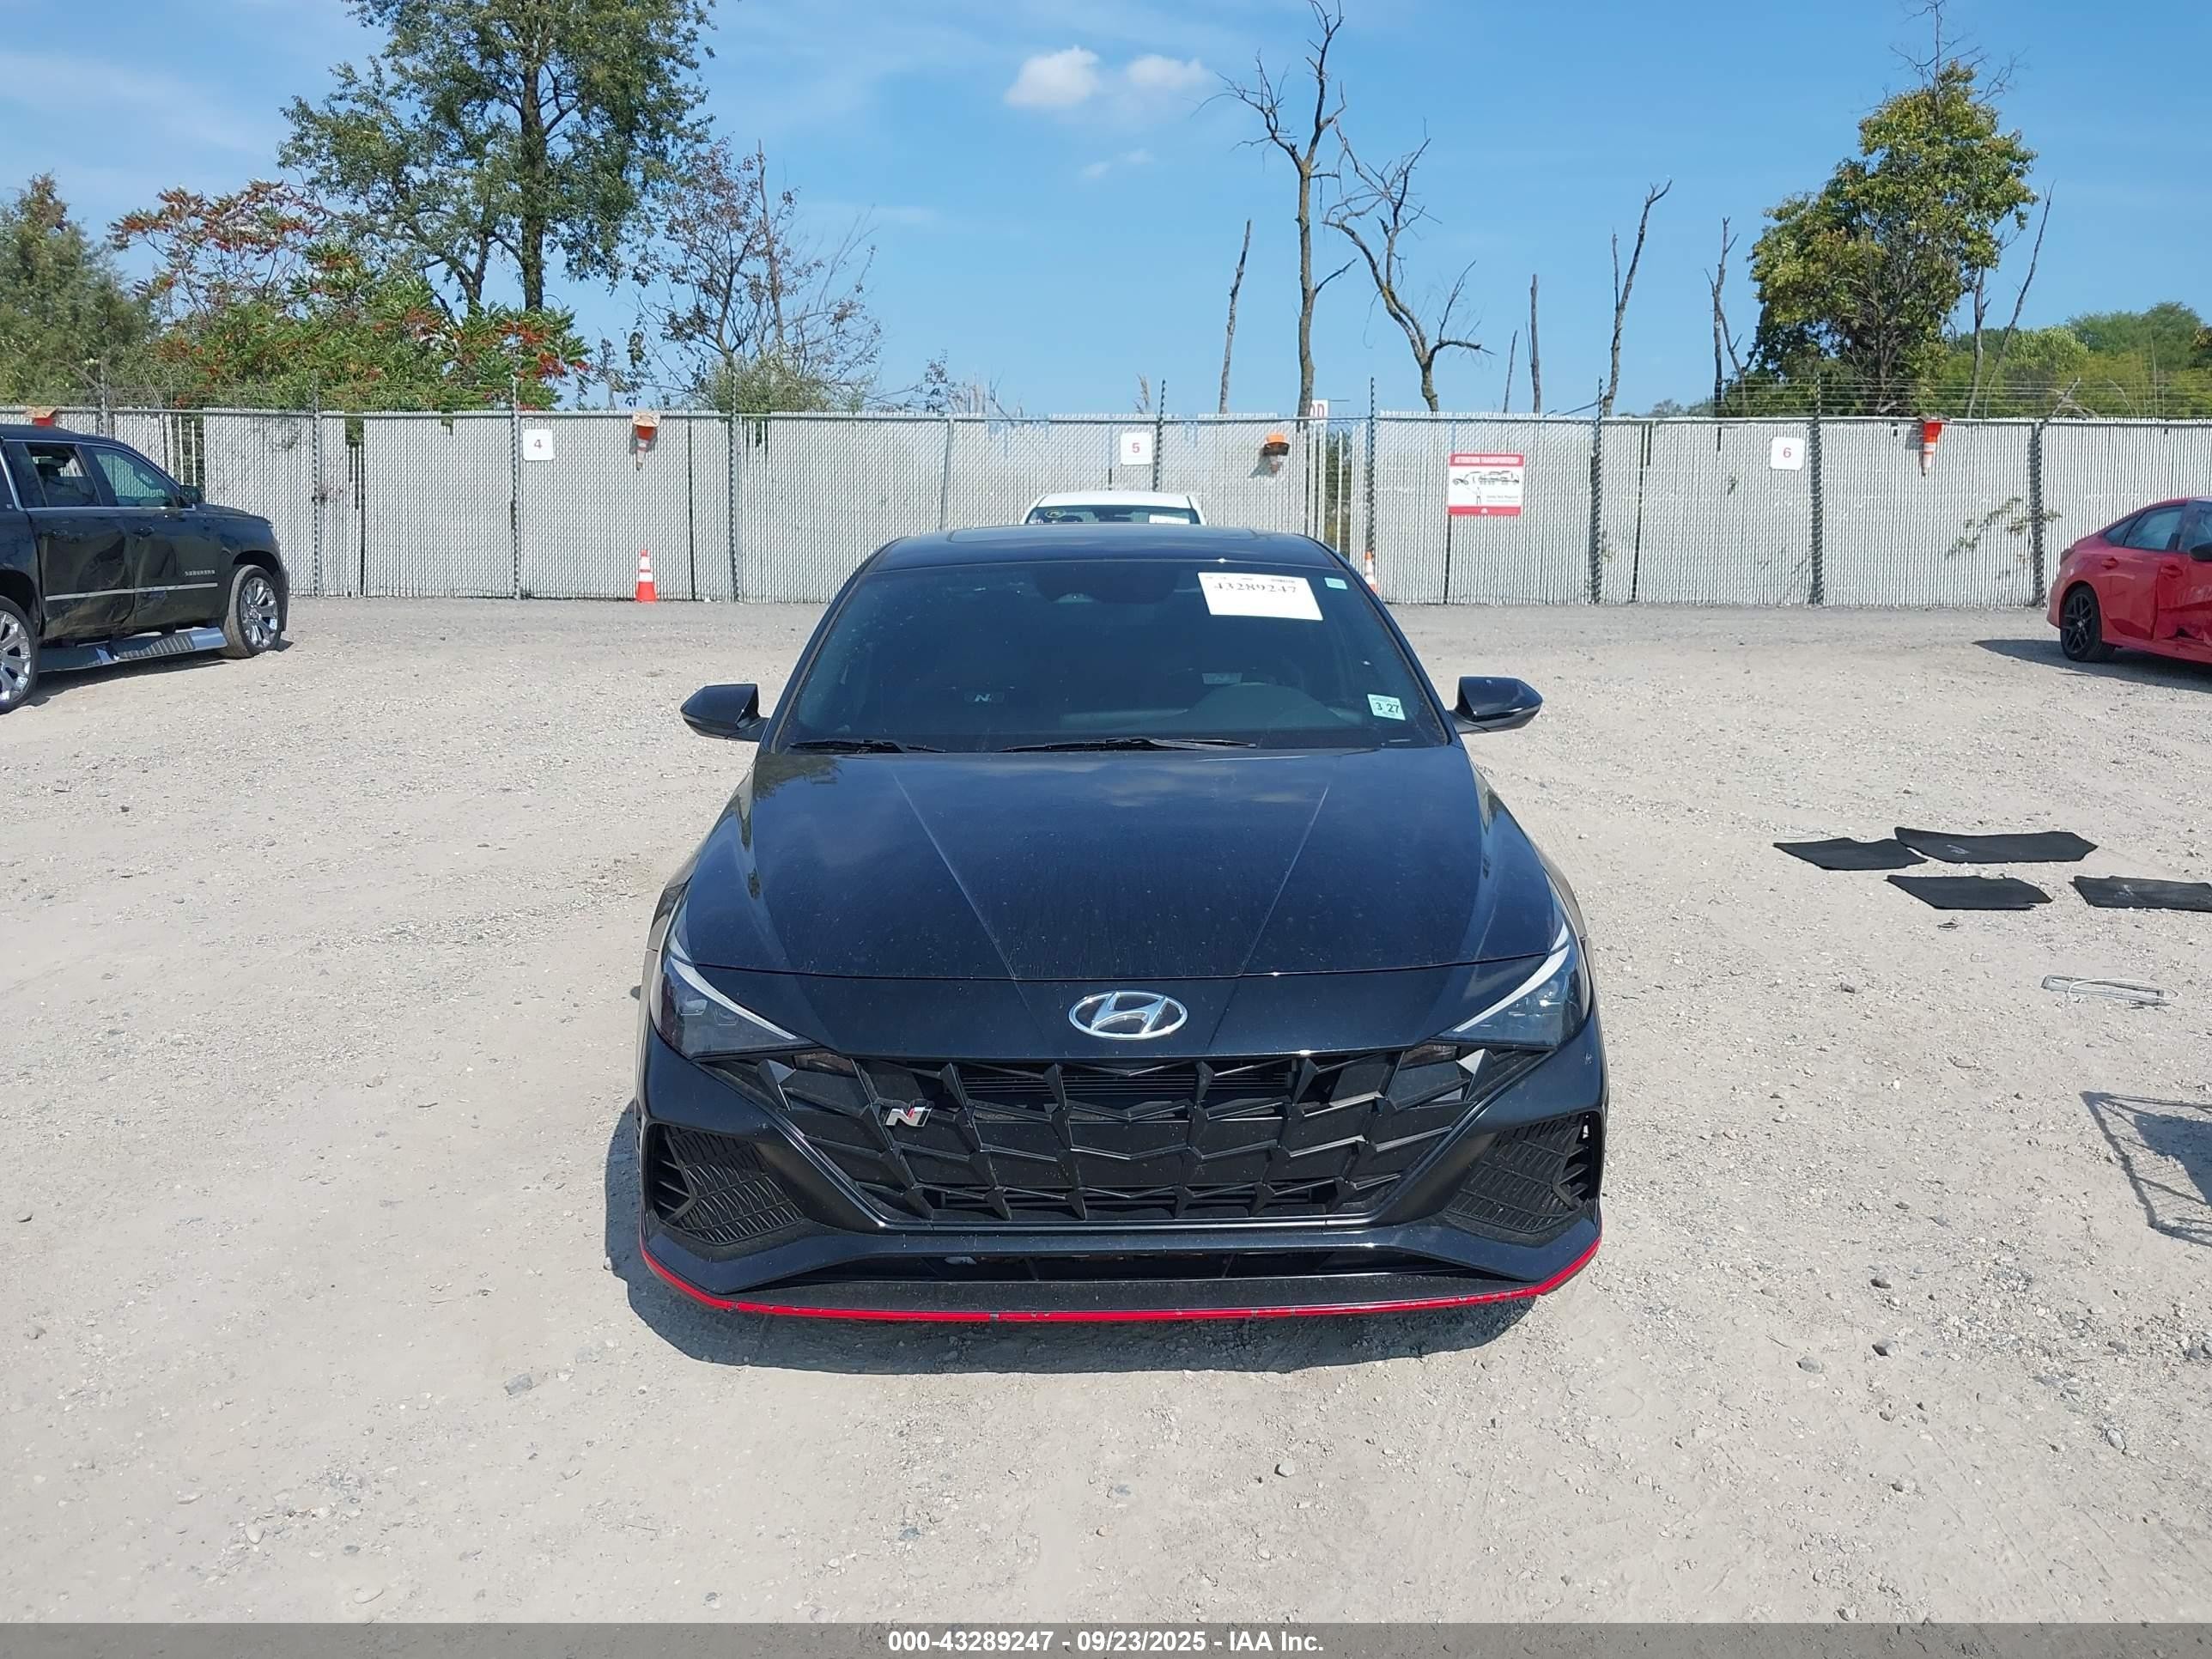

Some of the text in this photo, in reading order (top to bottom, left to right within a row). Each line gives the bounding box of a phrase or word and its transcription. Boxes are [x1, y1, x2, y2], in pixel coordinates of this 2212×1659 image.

[533, 439, 543, 449] 4
[1132, 442, 1140, 453] 5
[1783, 447, 1791, 459] 6
[1214, 582, 1297, 593] 43289247
[1376, 702, 1382, 711] 3
[1386, 702, 1400, 714] 27
[884, 1106, 933, 1127] N
